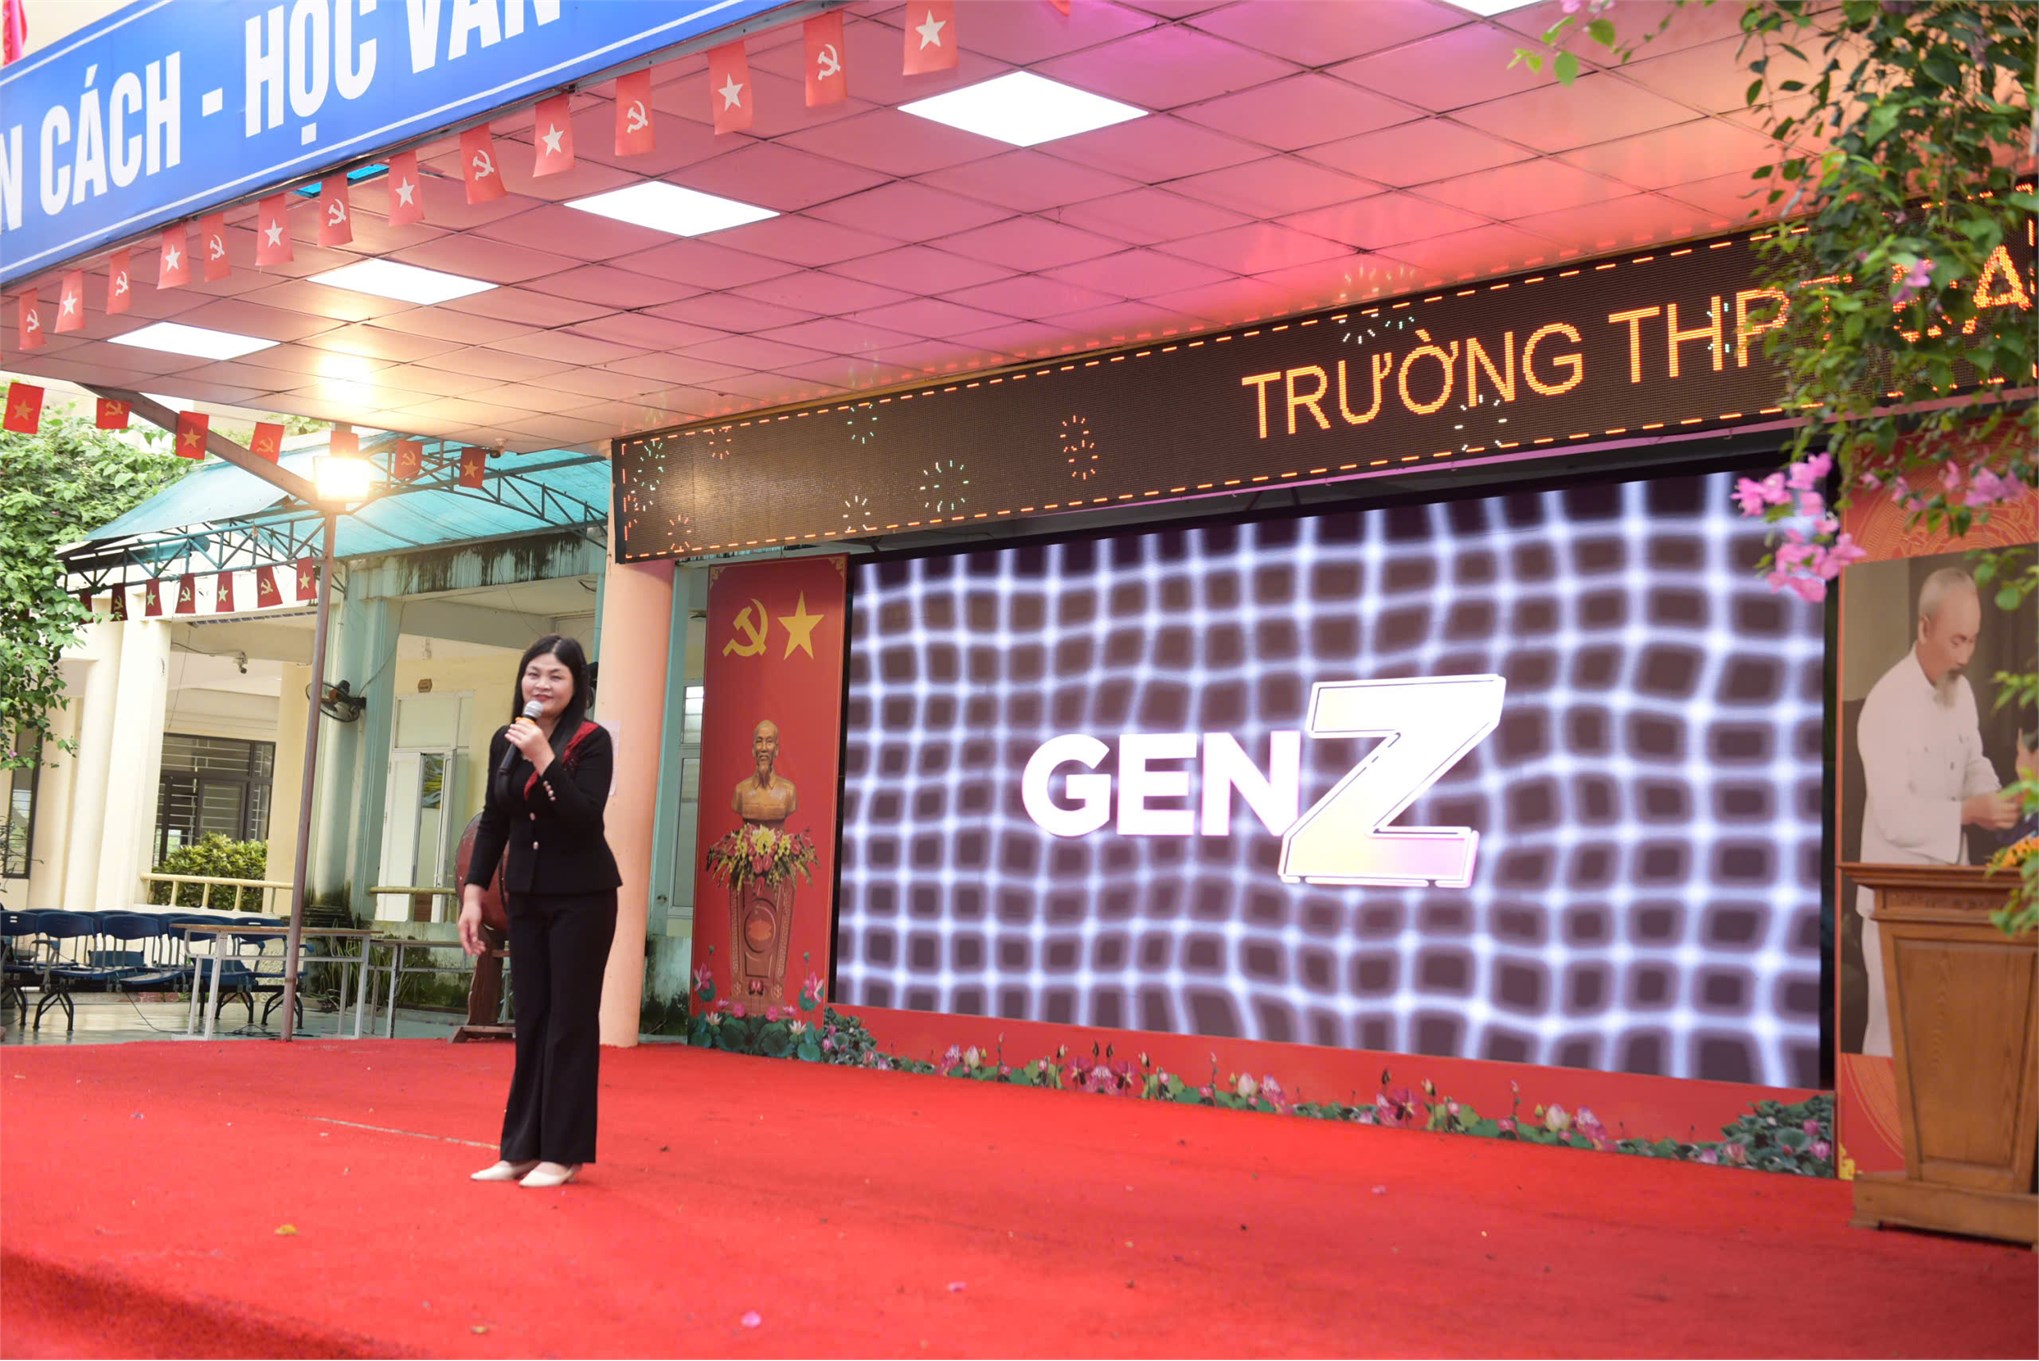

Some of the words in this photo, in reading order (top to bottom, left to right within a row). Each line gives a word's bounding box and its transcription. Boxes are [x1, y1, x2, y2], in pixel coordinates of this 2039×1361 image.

[40, 50, 181, 216] CÁCH
[245, 0, 377, 146] HỌC
[1241, 321, 1584, 439] TRƯỜNG
